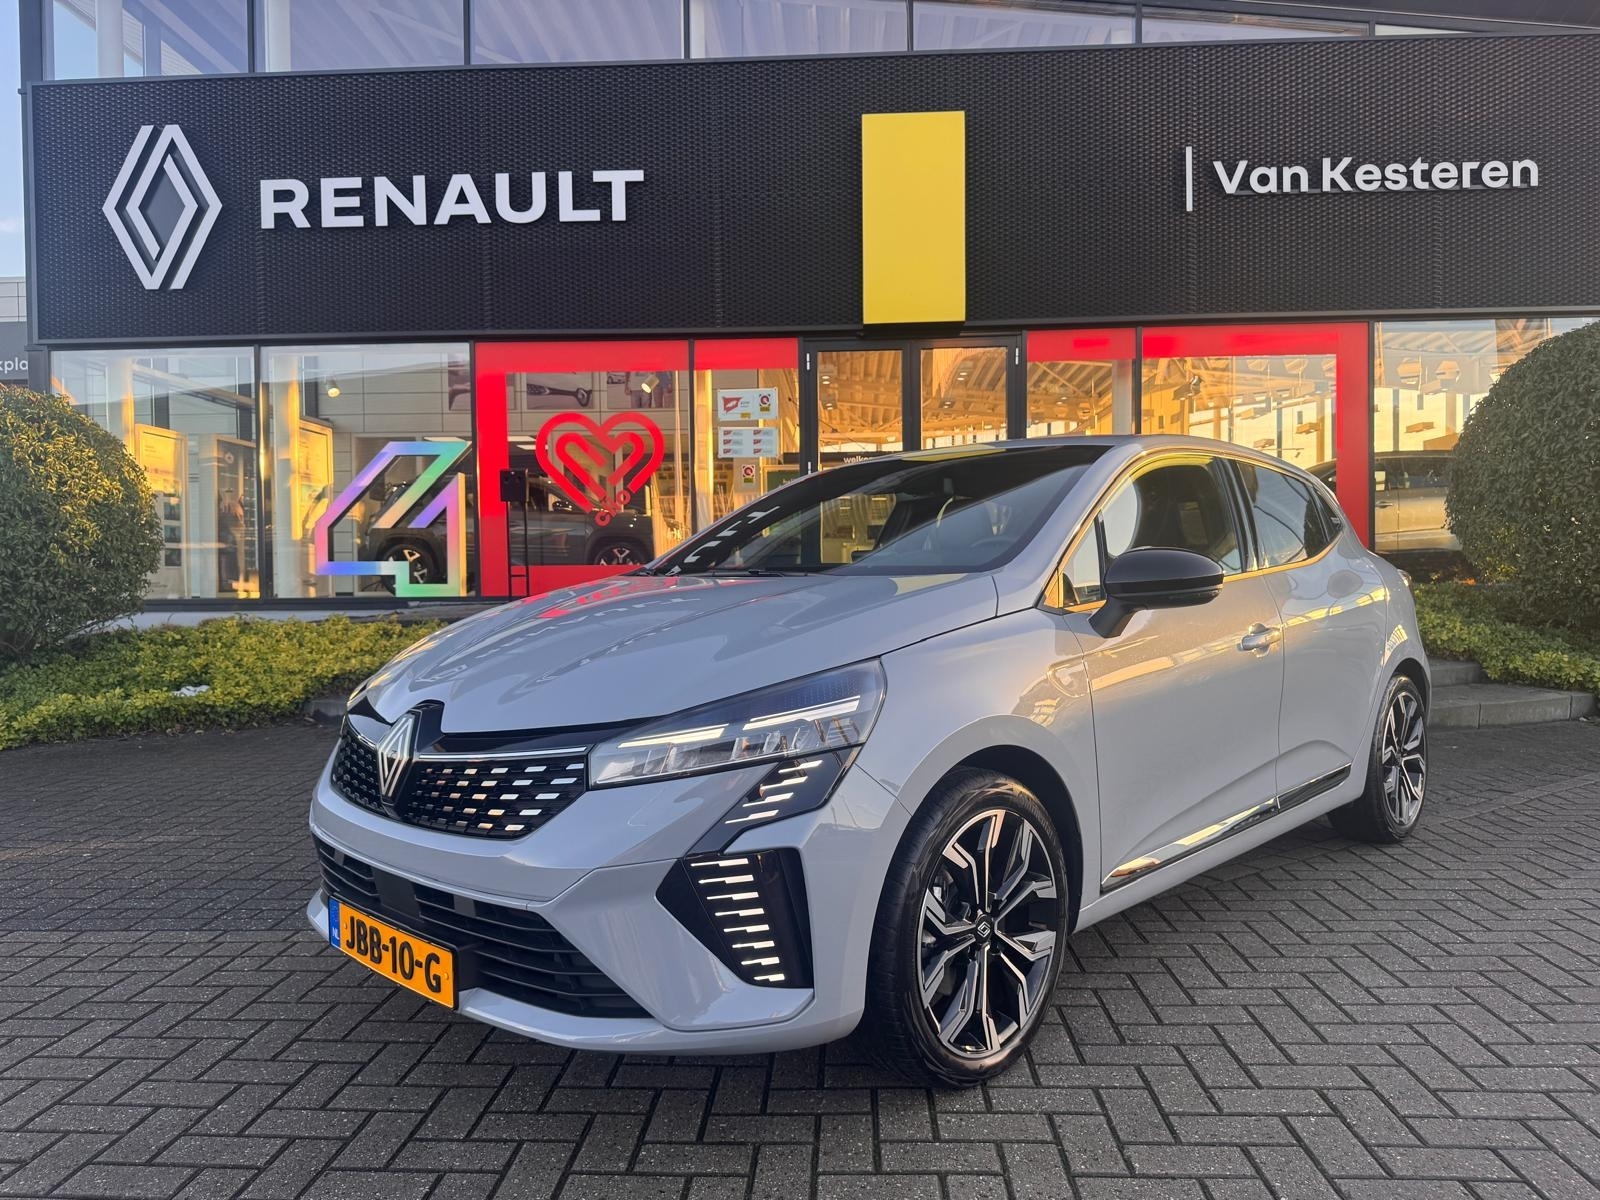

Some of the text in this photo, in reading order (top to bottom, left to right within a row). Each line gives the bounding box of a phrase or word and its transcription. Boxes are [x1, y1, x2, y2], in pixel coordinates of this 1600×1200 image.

[259, 169, 645, 229] RENAULT
[1212, 156, 1540, 194] Van Kesteren
[332, 926, 341, 940] NL
[345, 915, 442, 993] JBB-10-G
